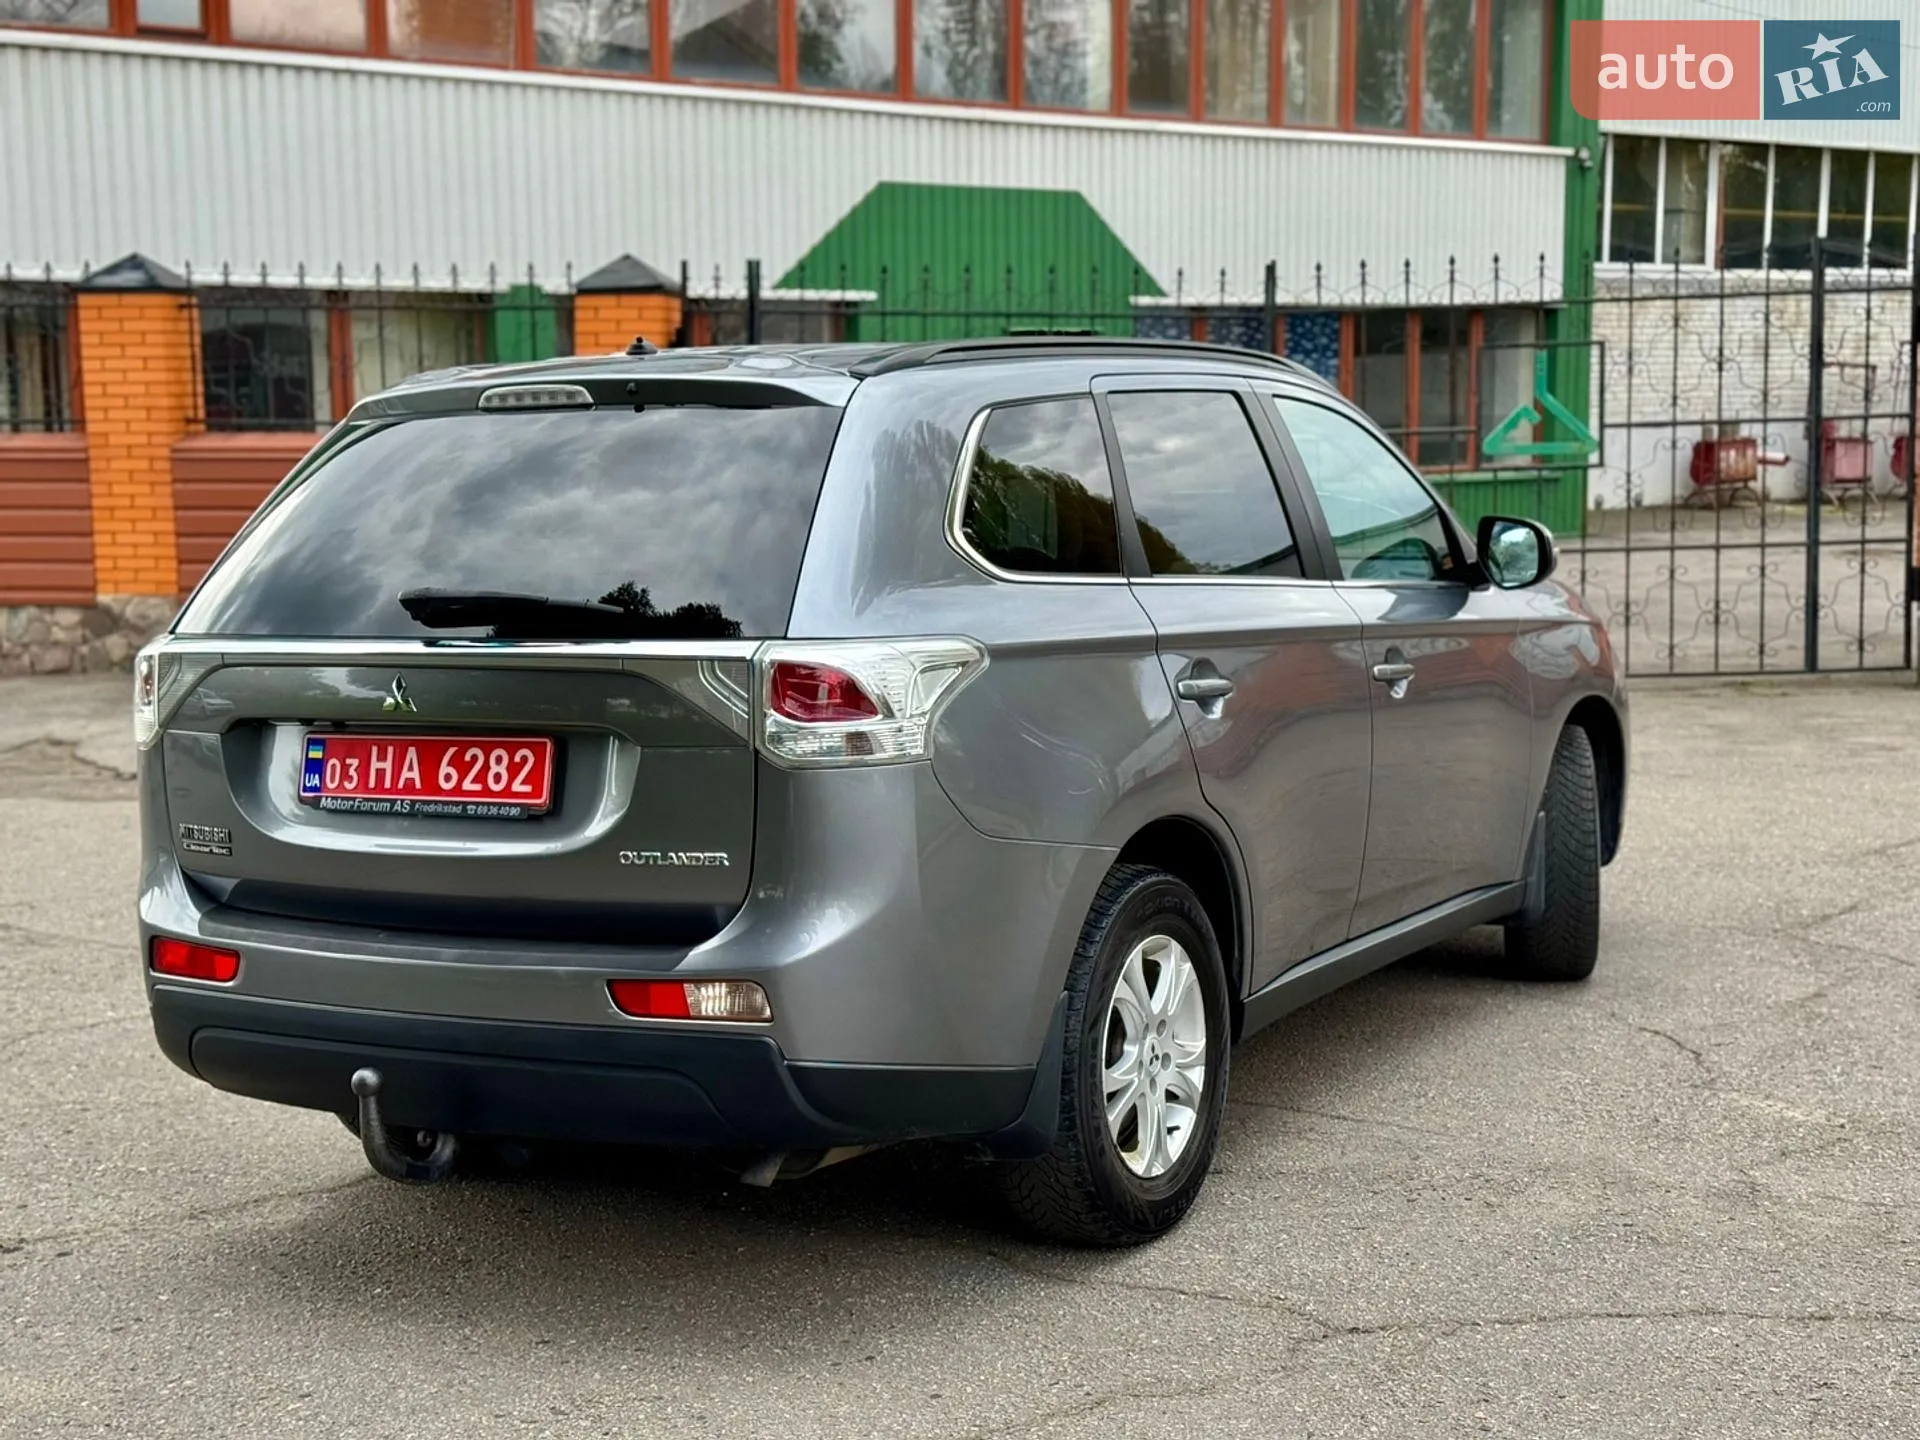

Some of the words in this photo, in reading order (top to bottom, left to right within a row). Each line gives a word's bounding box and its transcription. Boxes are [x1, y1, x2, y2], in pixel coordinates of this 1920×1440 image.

[325, 758, 360, 790] 03
[368, 745, 422, 789] HA
[438, 746, 535, 793] 6282
[305, 773, 320, 787] UA
[320, 797, 391, 812] MotorForum
[391, 800, 411, 813] AS
[619, 850, 730, 867] OUTLANDER
